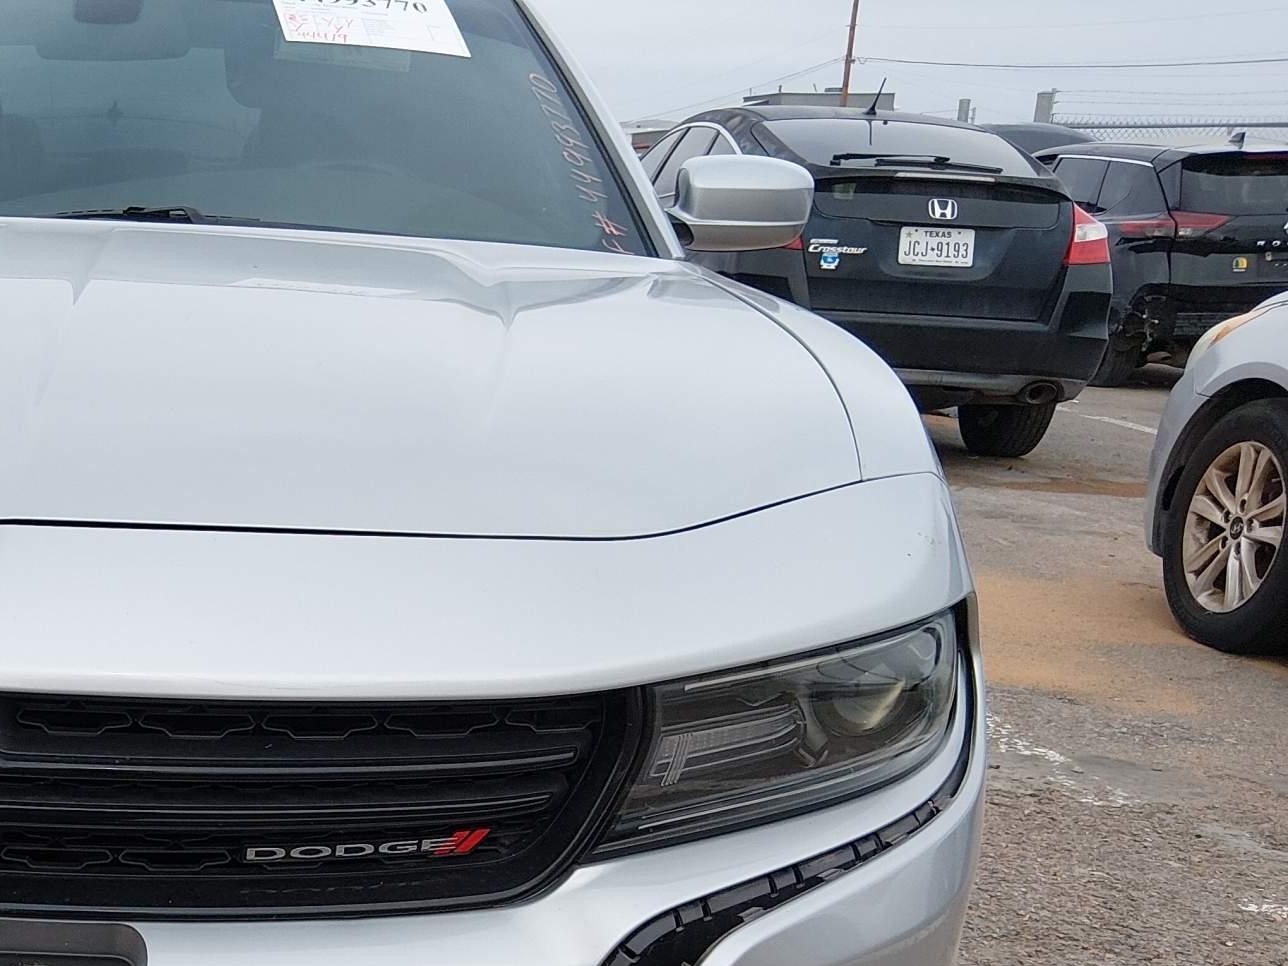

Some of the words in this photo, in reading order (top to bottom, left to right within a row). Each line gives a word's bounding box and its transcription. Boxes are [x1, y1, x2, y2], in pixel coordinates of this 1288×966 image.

[924, 230, 952, 239] TEXAS
[807, 243, 868, 254] Crosstour
[246, 837, 459, 861] DODGE
